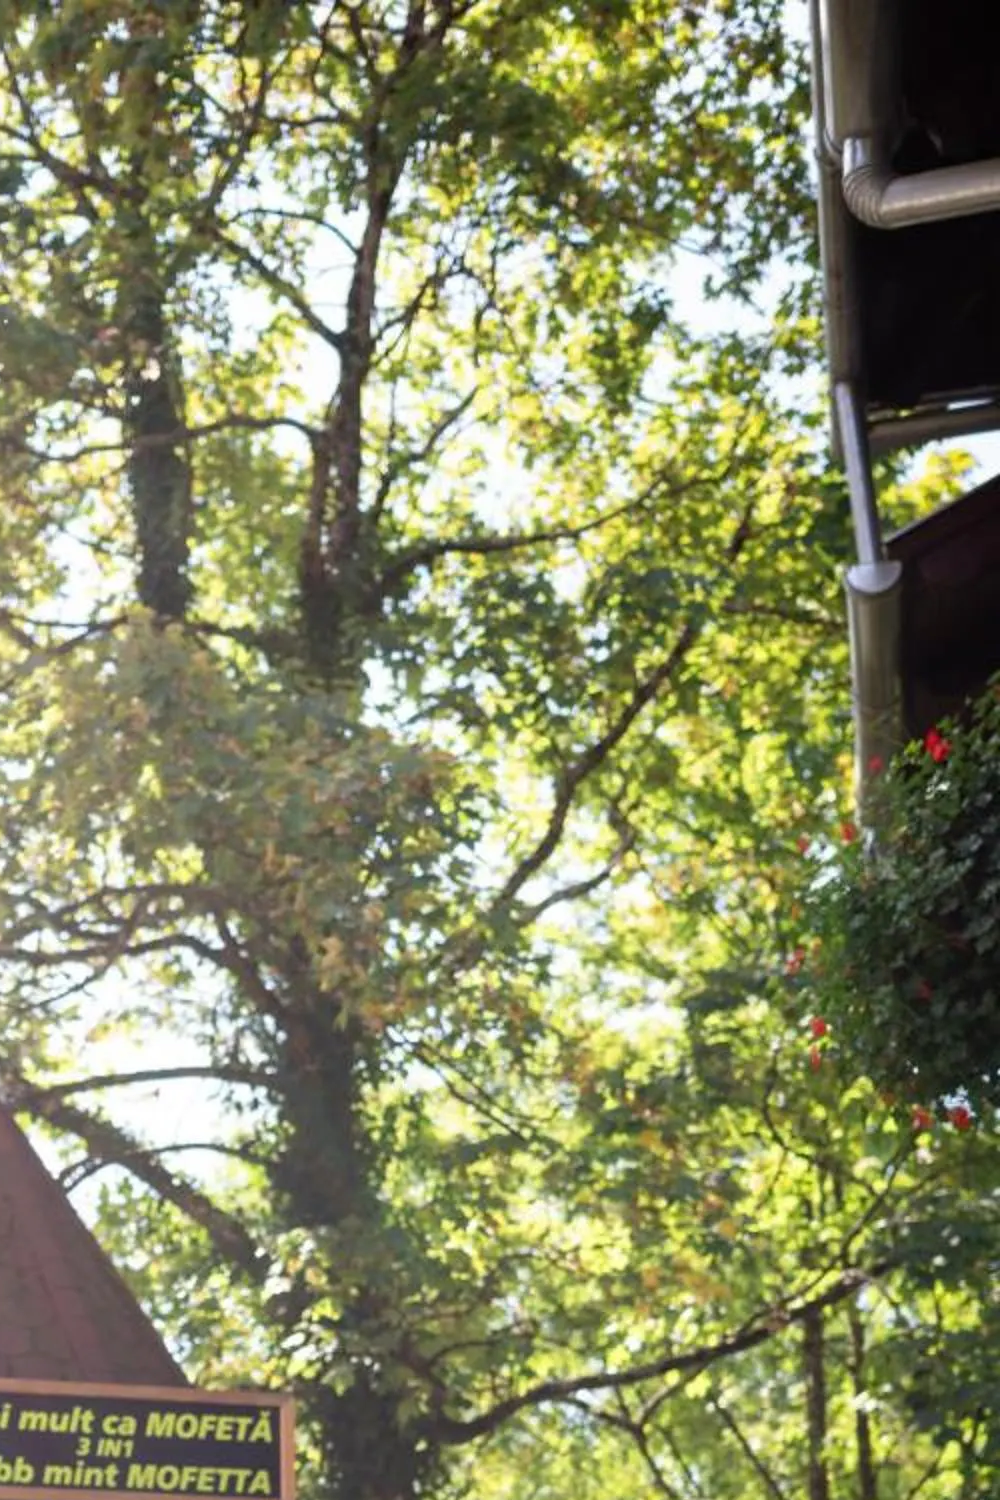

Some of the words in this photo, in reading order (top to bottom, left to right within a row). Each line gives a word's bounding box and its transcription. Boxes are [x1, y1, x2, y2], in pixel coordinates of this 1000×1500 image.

[18, 1406, 95, 1434] mult
[102, 1414, 137, 1436] ca
[145, 1410, 273, 1443] MOFETĂ
[76, 1436, 91, 1457] 3
[43, 1460, 119, 1488] mint
[126, 1463, 272, 1496] MOFETTA
